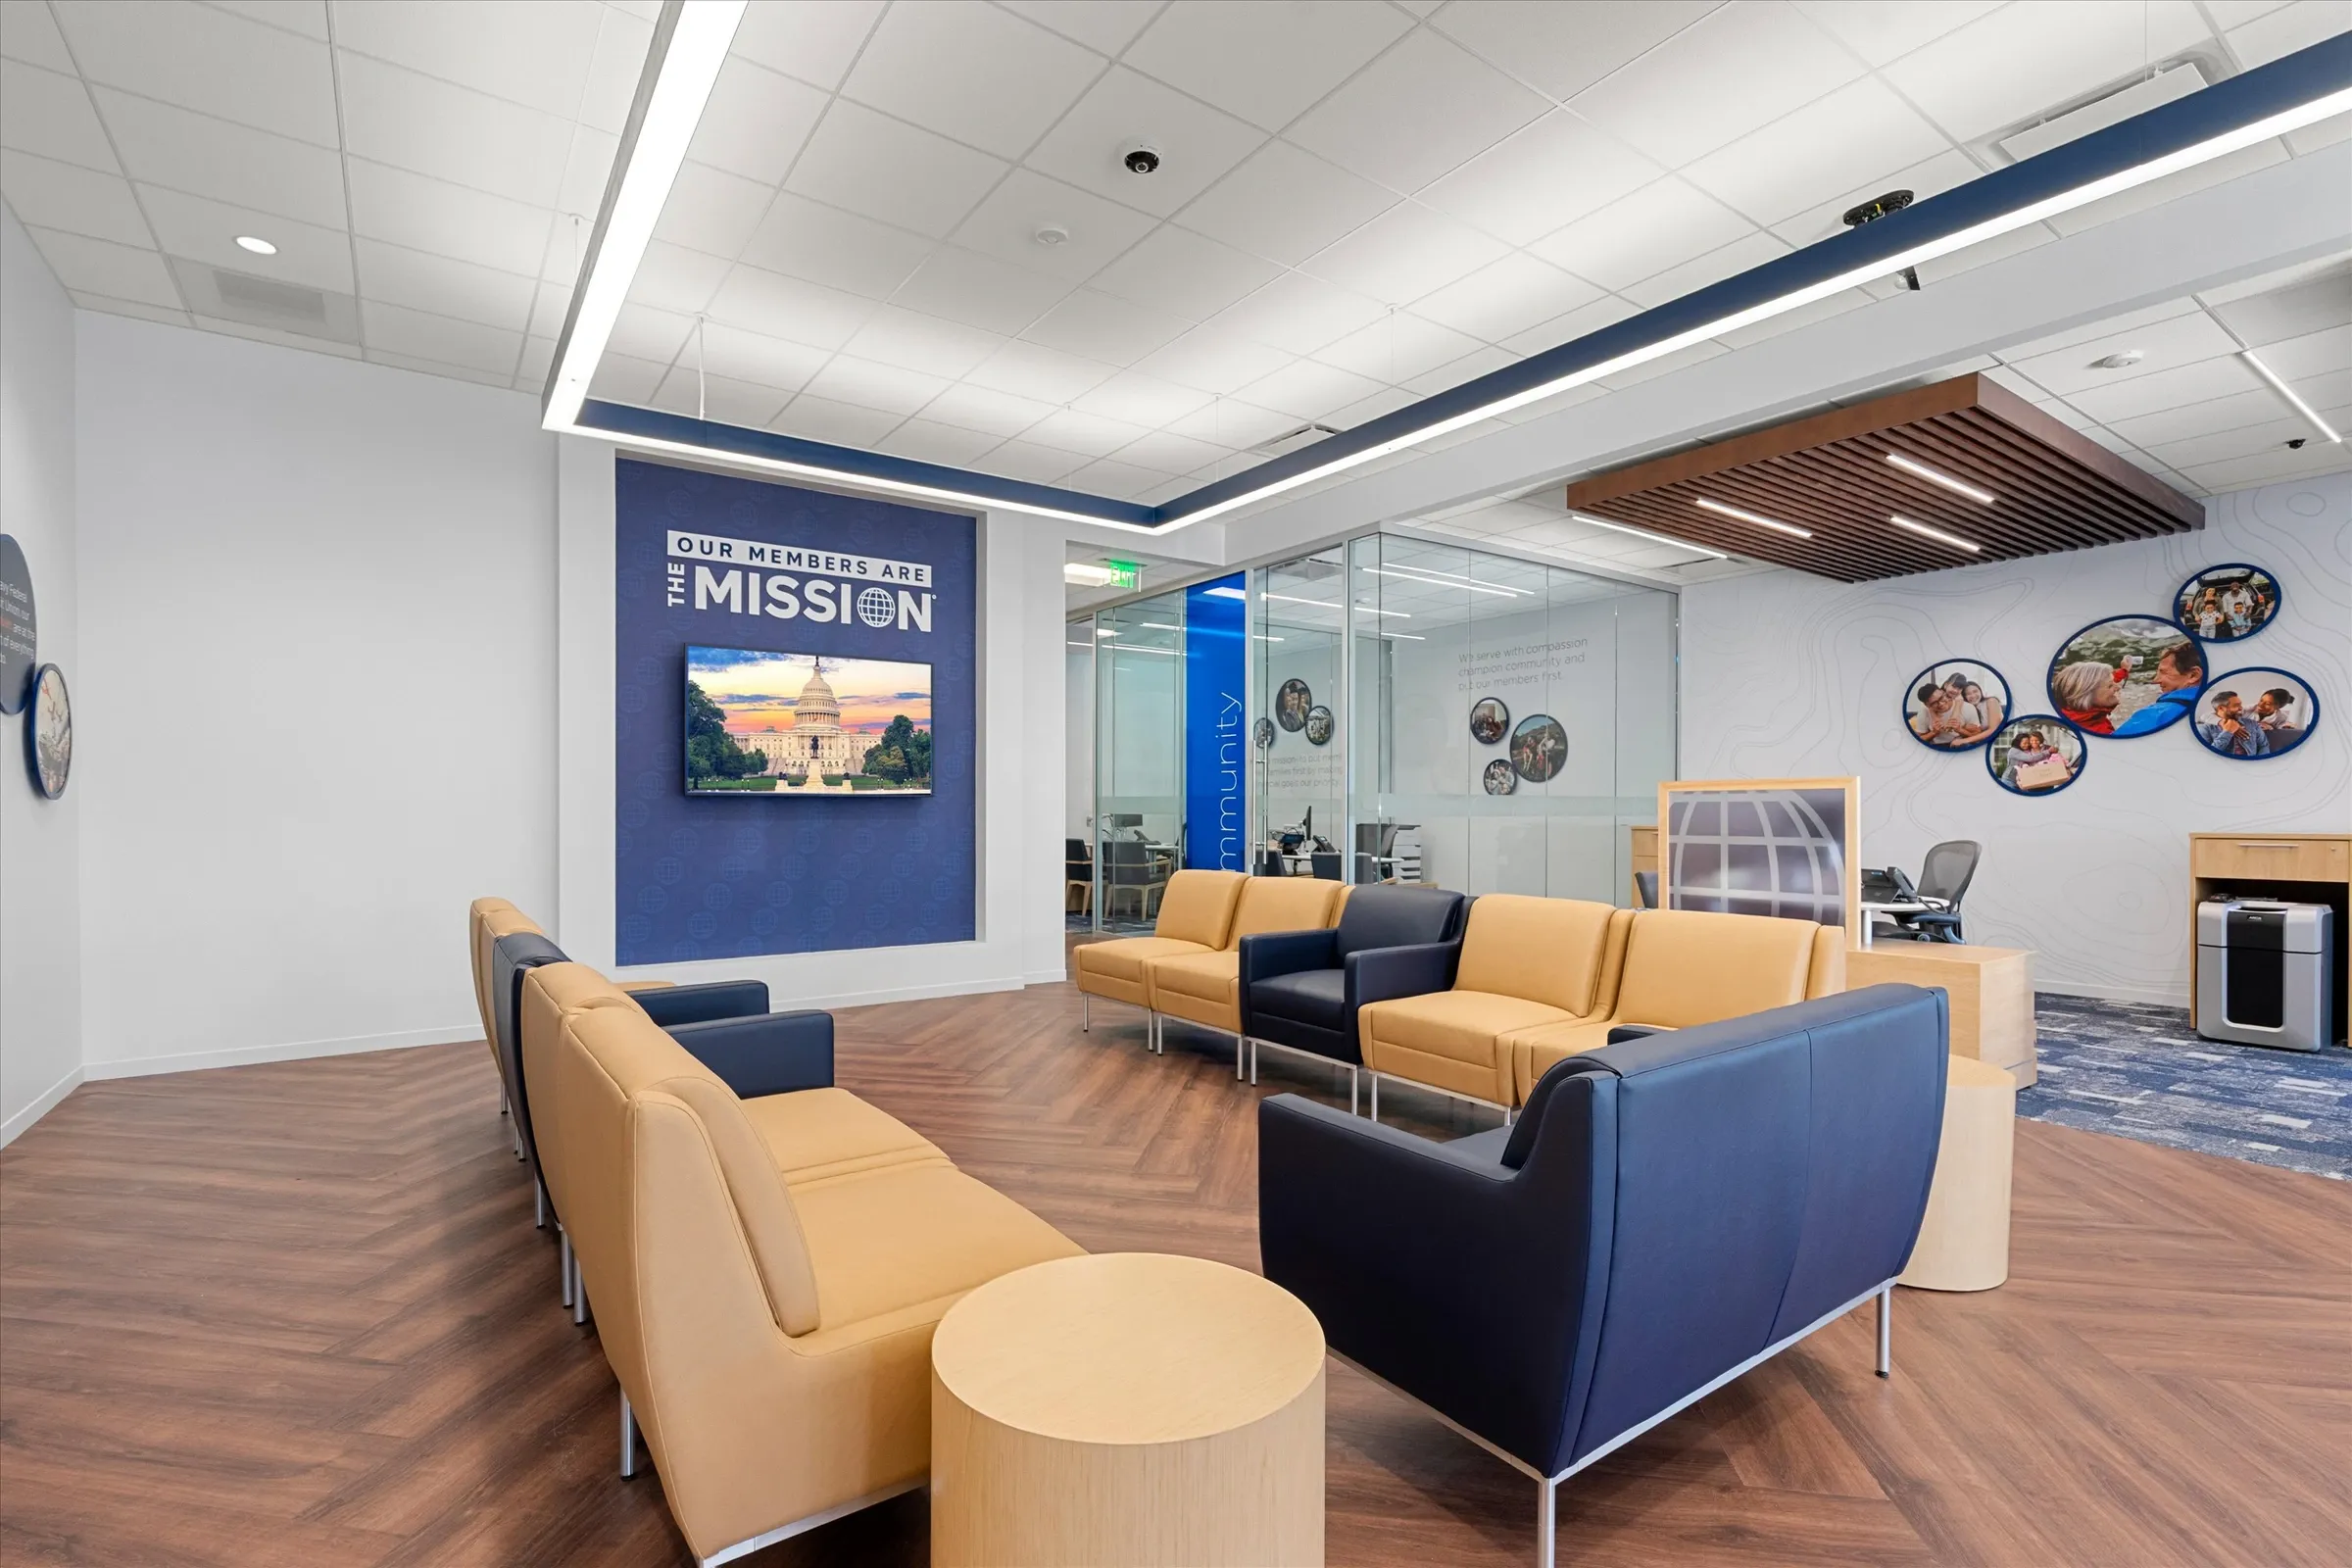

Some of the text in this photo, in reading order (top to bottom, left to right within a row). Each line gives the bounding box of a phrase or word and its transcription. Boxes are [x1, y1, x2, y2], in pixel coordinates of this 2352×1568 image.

[677, 537, 925, 582] OUR MEMBERS ARE
[1109, 565, 1137, 588] EXIT
[667, 563, 932, 632] THE MISSION
[1458, 654, 1474, 663] We
[1476, 650, 1501, 662] serve
[1504, 646, 1525, 657] with
[1458, 652, 1586, 677] champion community and
[1476, 680, 1492, 690] our
[1494, 674, 1539, 688] members
[1215, 692, 1242, 870] mmunity
